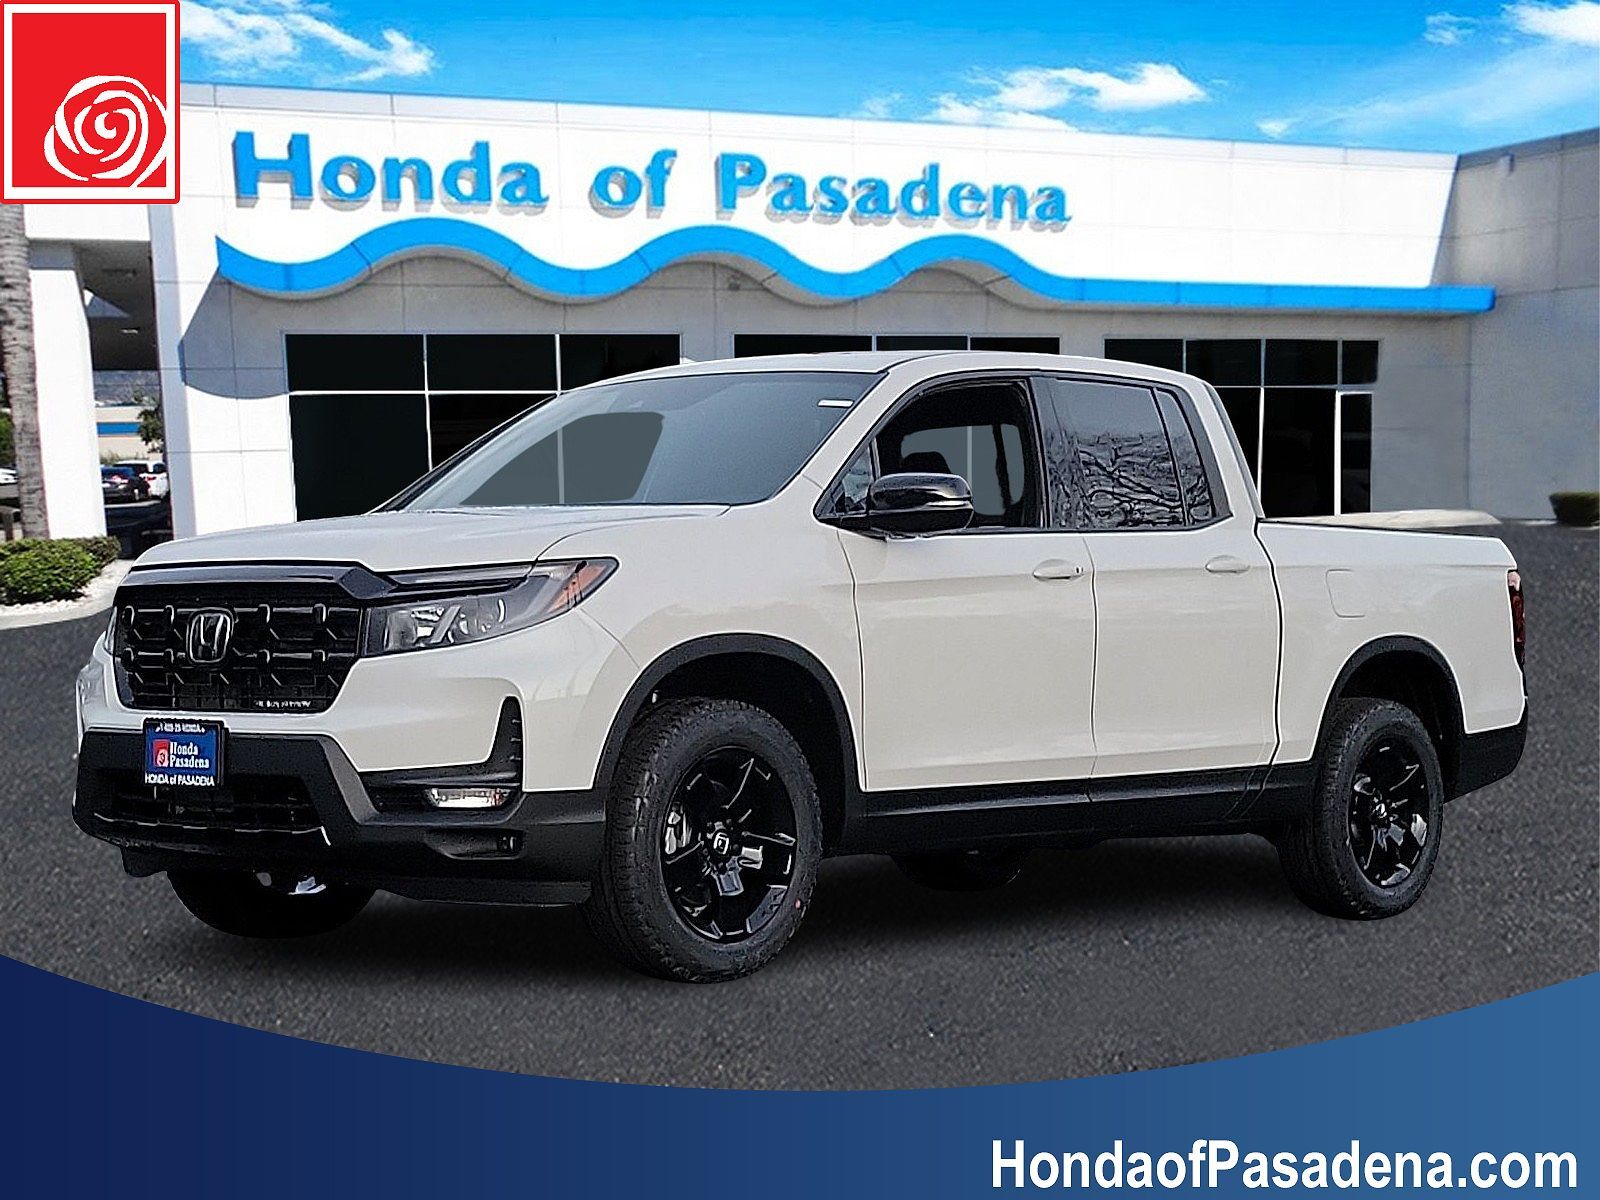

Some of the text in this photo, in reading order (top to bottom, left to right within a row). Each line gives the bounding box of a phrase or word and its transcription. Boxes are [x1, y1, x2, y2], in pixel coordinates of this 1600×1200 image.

[232, 131, 1072, 226] Honda of Pasadena
[169, 741, 199, 756] Honda
[169, 755, 210, 769] Pasadena
[144, 772, 169, 785] HONDA
[178, 774, 215, 787] PASADENA
